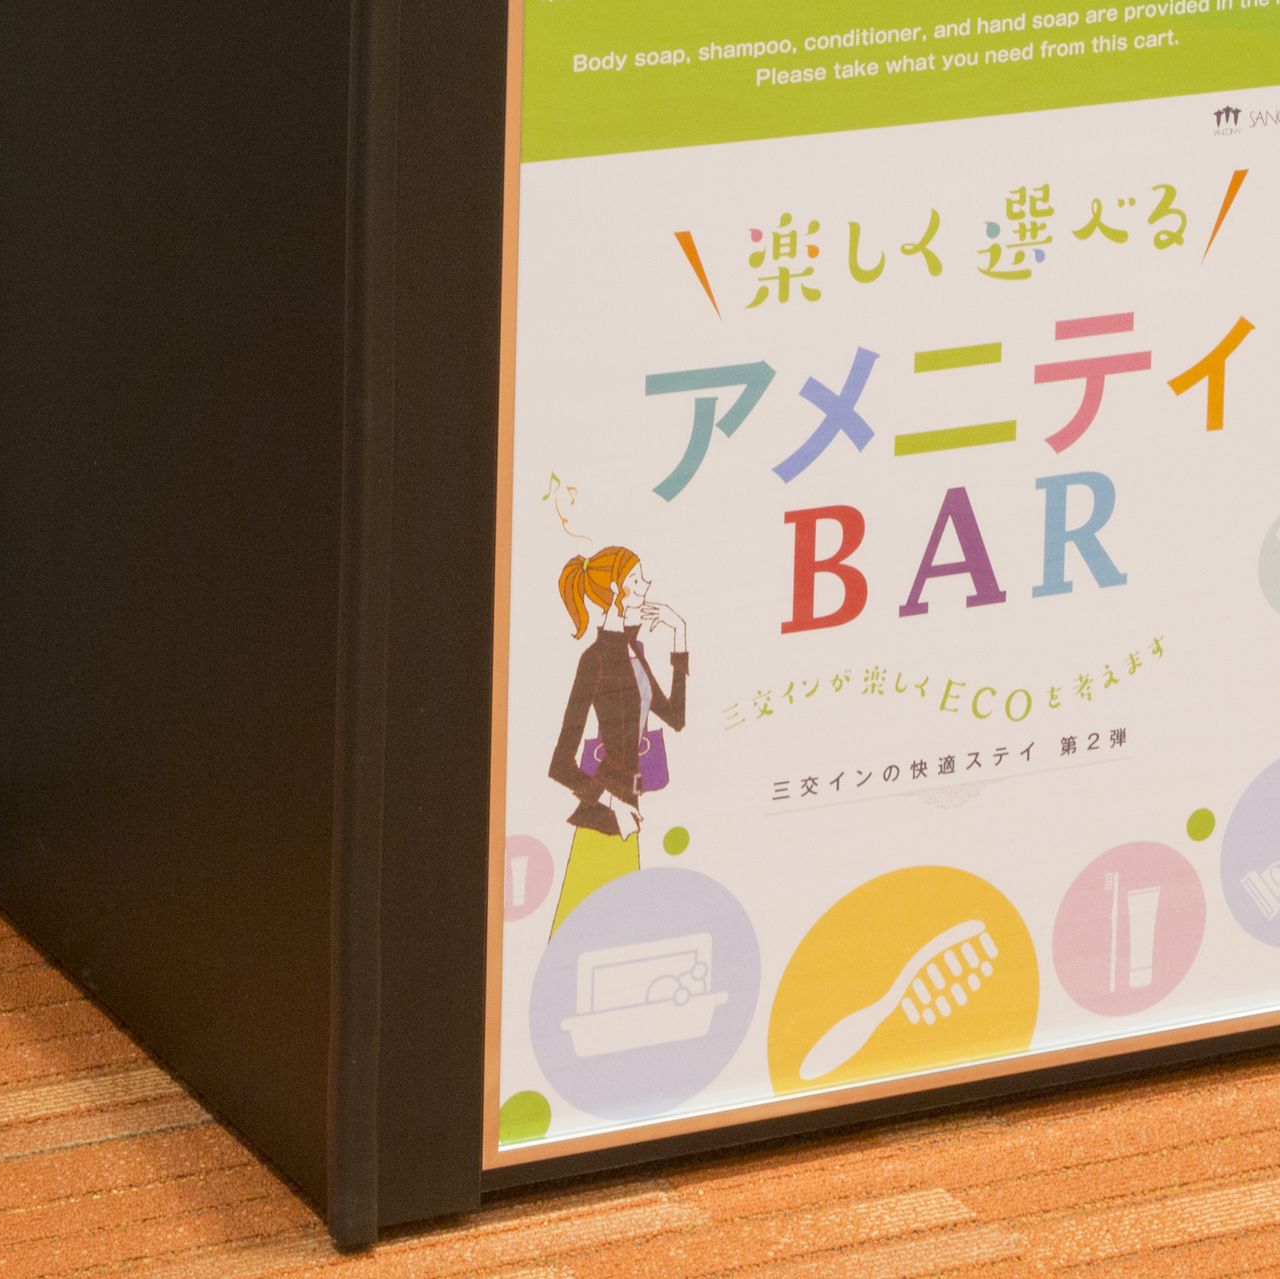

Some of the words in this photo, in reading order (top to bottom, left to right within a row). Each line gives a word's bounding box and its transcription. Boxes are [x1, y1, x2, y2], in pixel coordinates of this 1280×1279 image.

[572, 51, 628, 73] Body
[634, 48, 691, 67] soap,
[698, 40, 798, 60] shampoo,
[803, 27, 927, 52] conditioner,
[933, 19, 971, 39] and
[976, 12, 1026, 34] hand
[1032, 11, 1080, 30] soap
[1085, 7, 1119, 25] are
[755, 66, 827, 87] Please
[833, 59, 879, 80] take
[885, 53, 936, 74] what
[942, 52, 979, 71] you
[984, 42, 1034, 65] need
[1039, 40, 1085, 59] from
[1091, 34, 1128, 54] this
[1133, 30, 1179, 49] cart.
[743, 183, 1188, 309] 楽しく選べる
[644, 310, 1256, 503] アメニティ
[780, 469, 1129, 635] BAR
[771, 741, 1037, 802] 三交インの快適ステイ
